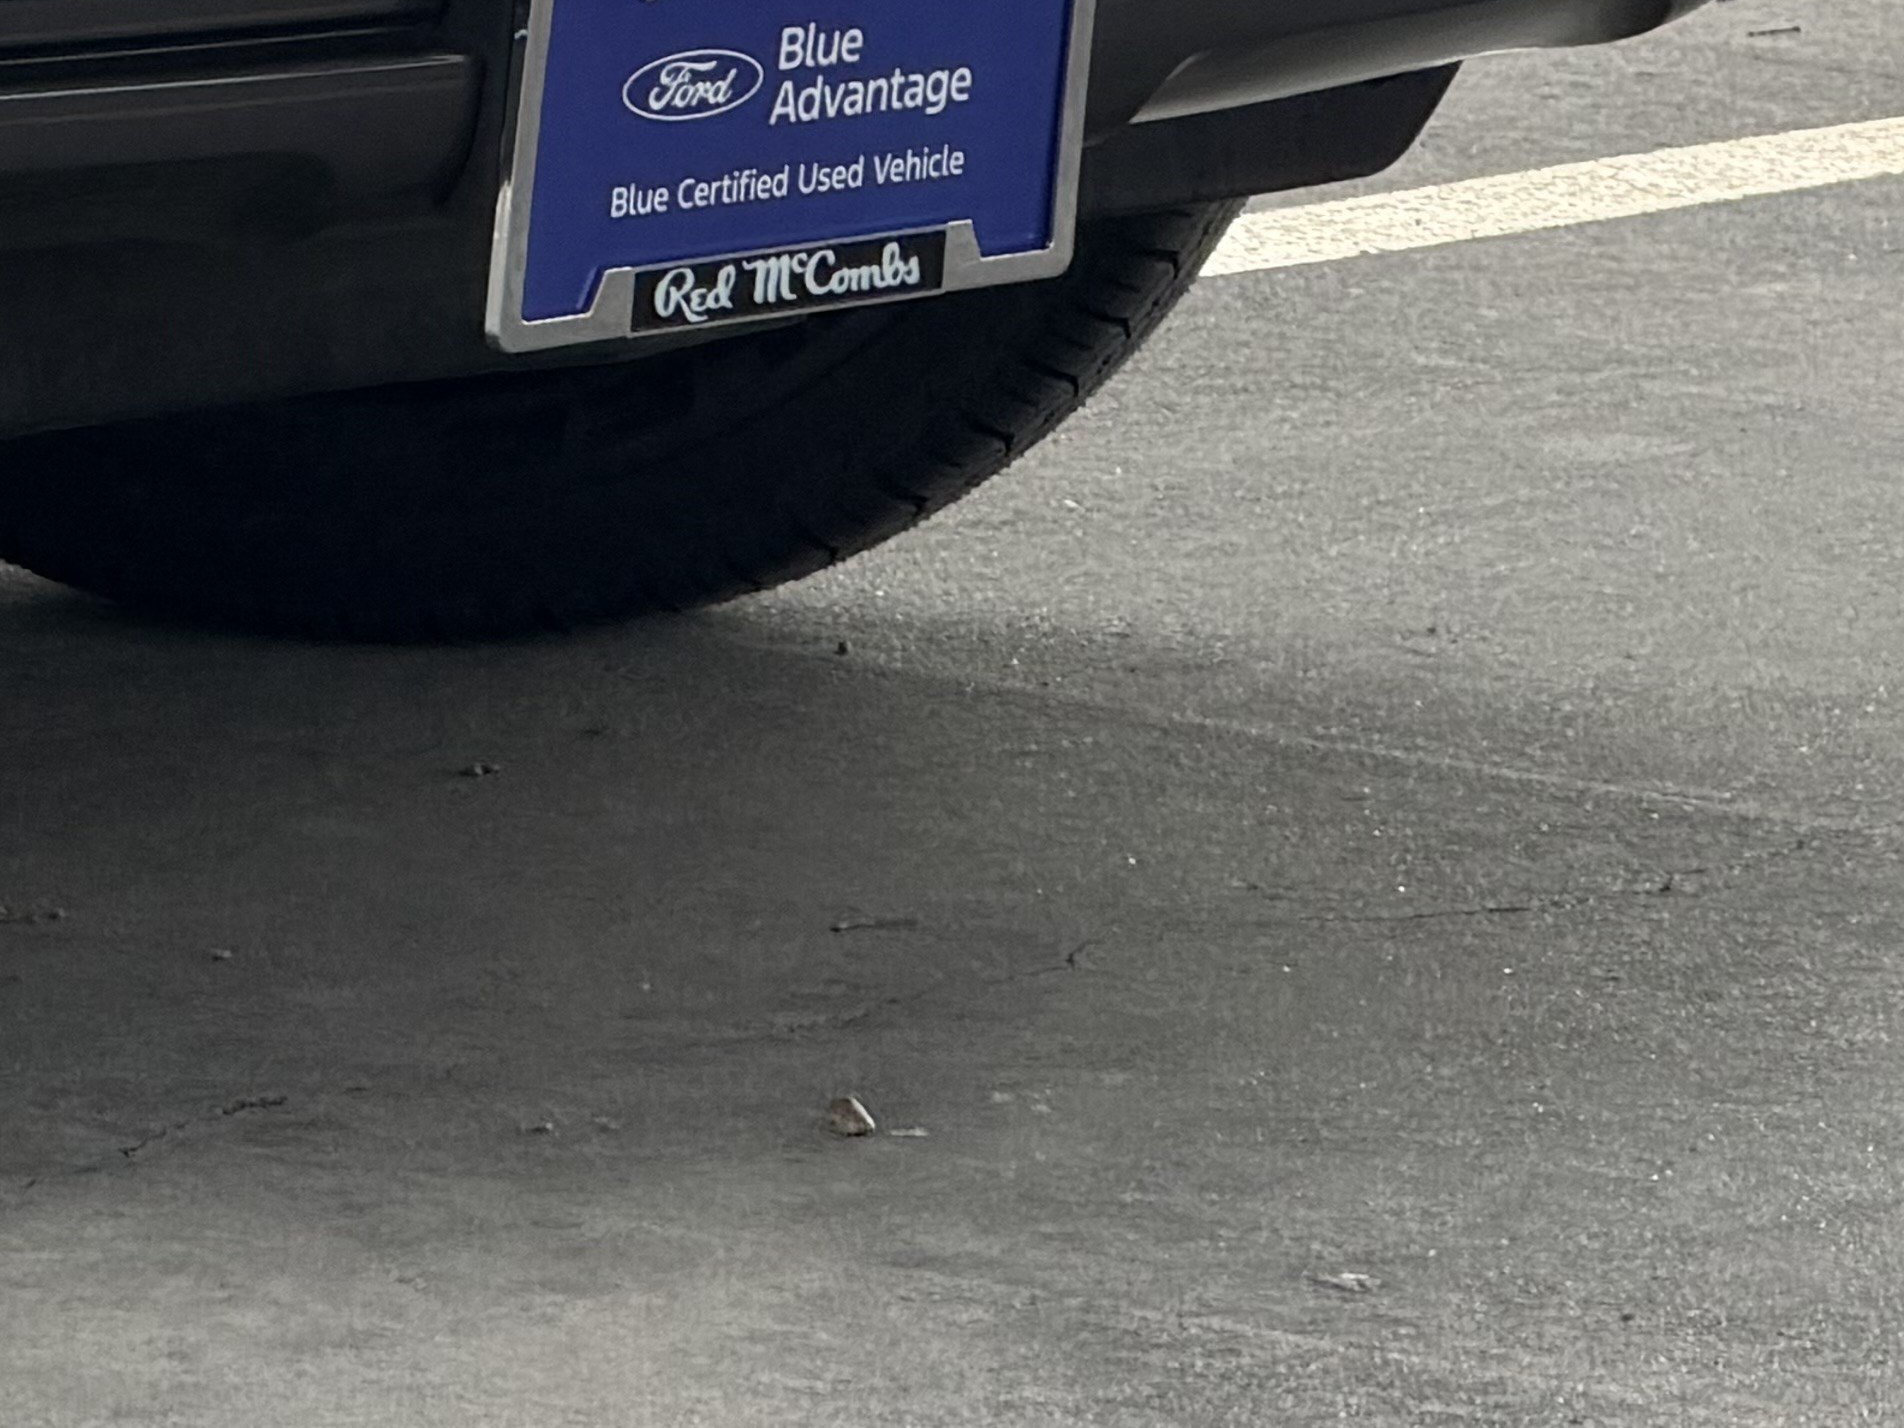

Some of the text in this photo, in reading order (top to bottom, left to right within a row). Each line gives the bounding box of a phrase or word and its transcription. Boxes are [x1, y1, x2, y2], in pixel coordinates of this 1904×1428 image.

[778, 22, 863, 70] Blue
[648, 61, 737, 111] Ford
[769, 66, 972, 125] Advantage
[610, 144, 964, 218] Blue Certified Used Vehicle
[654, 242, 920, 322] Red McCombs
